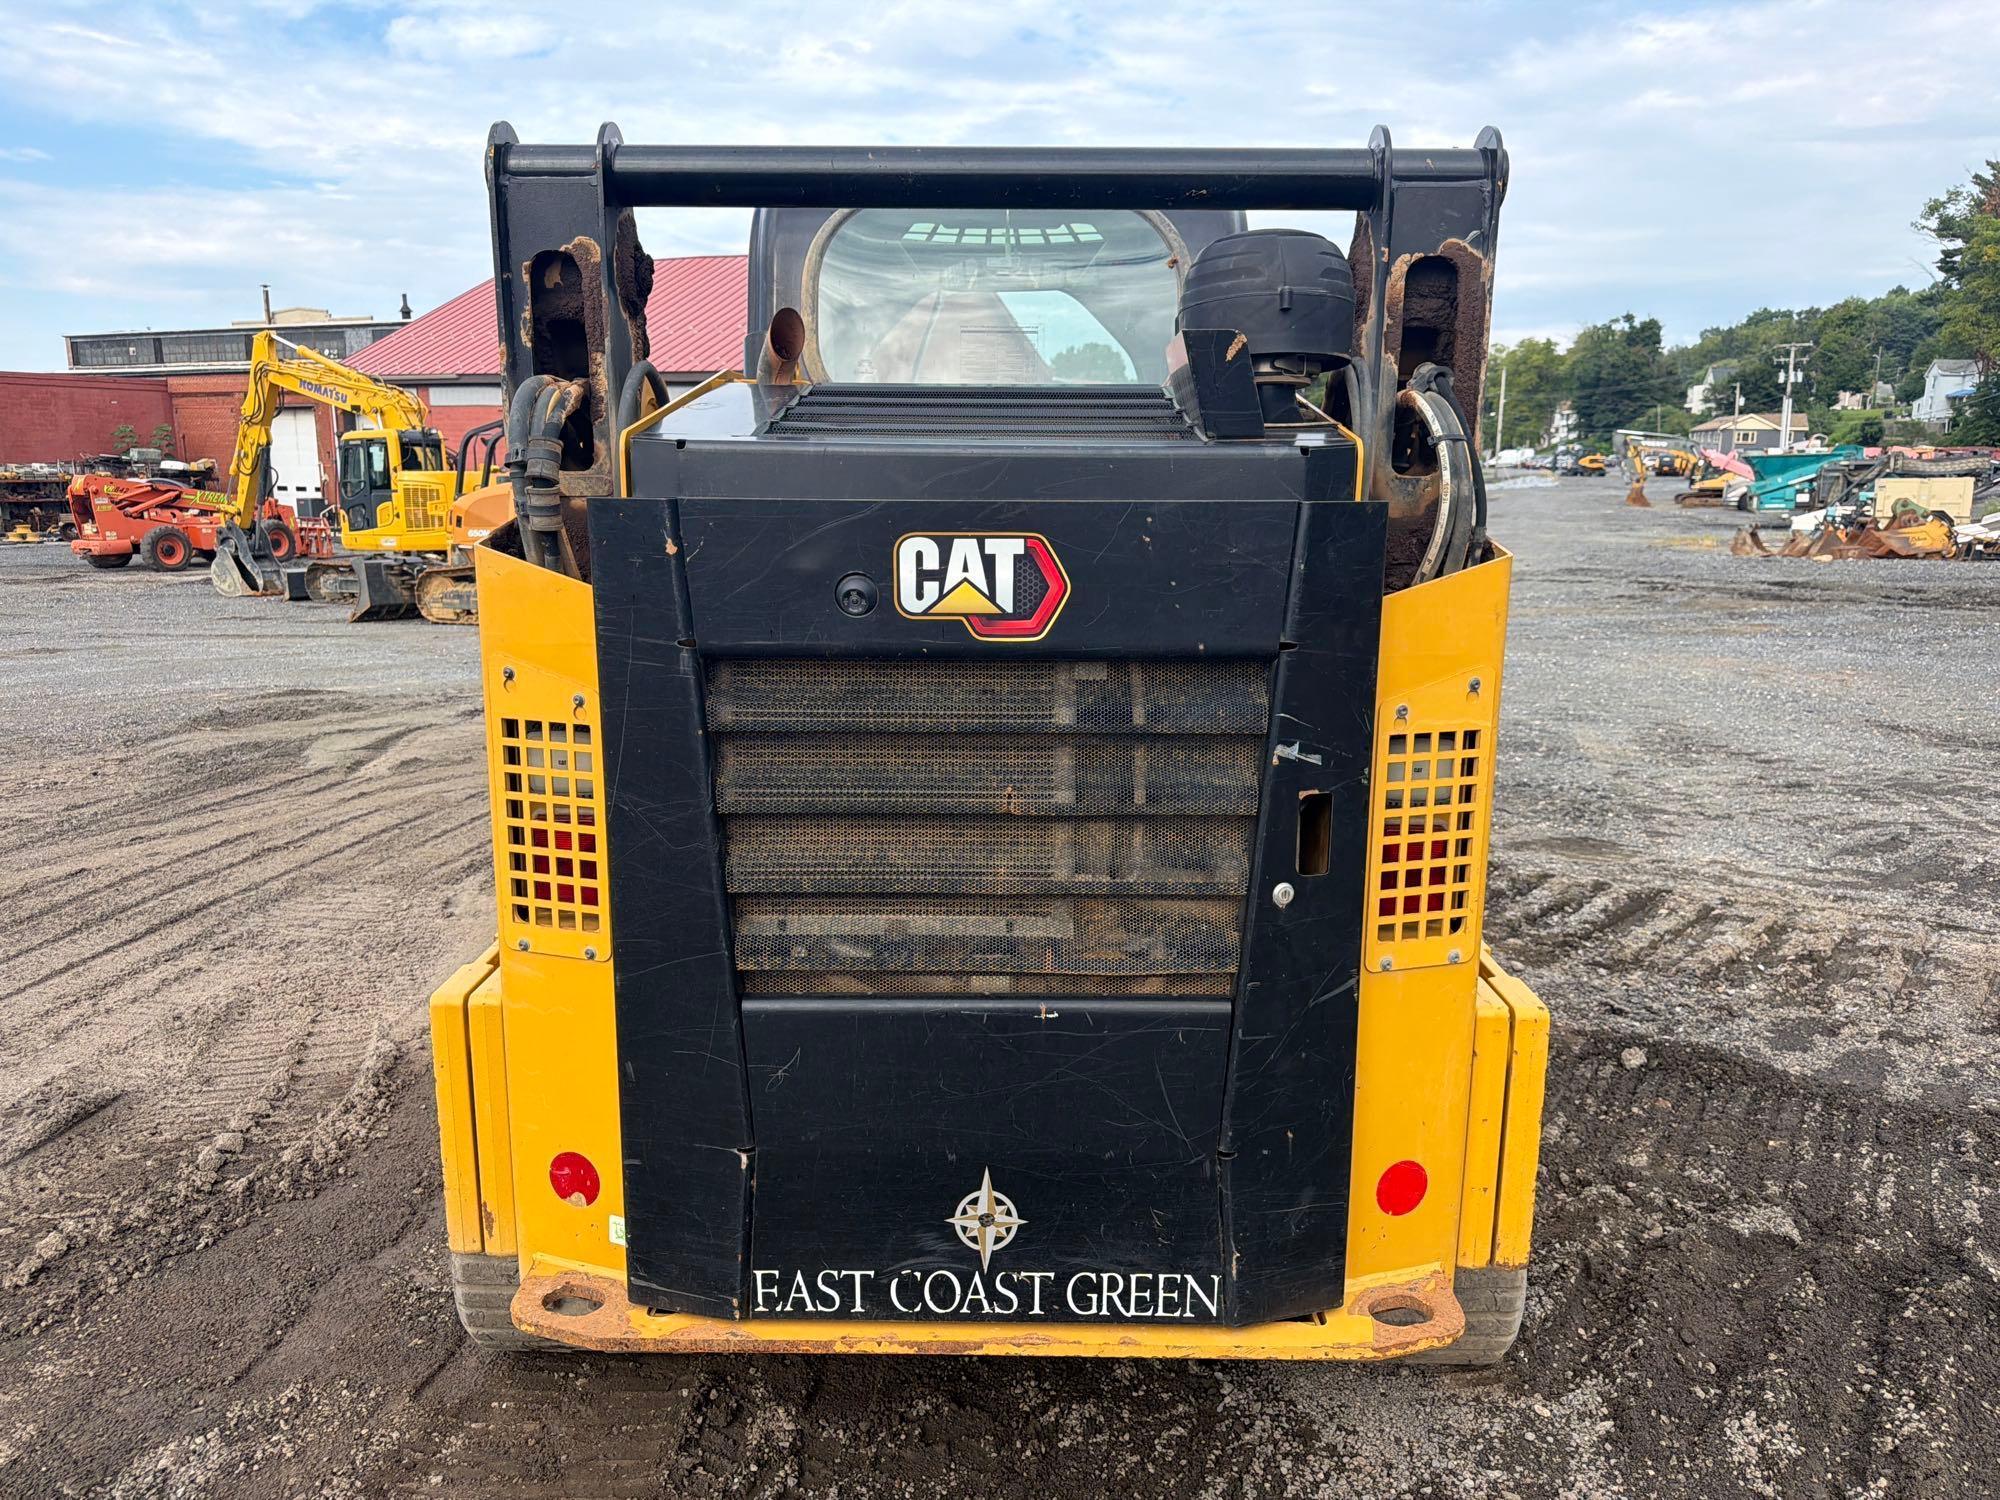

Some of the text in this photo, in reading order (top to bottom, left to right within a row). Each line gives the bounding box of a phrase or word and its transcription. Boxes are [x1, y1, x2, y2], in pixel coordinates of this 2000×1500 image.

[299, 379, 347, 404] KOMATSU
[899, 536, 1025, 614] CAT
[752, 1269, 1223, 1318] EAST COAST GREEN
